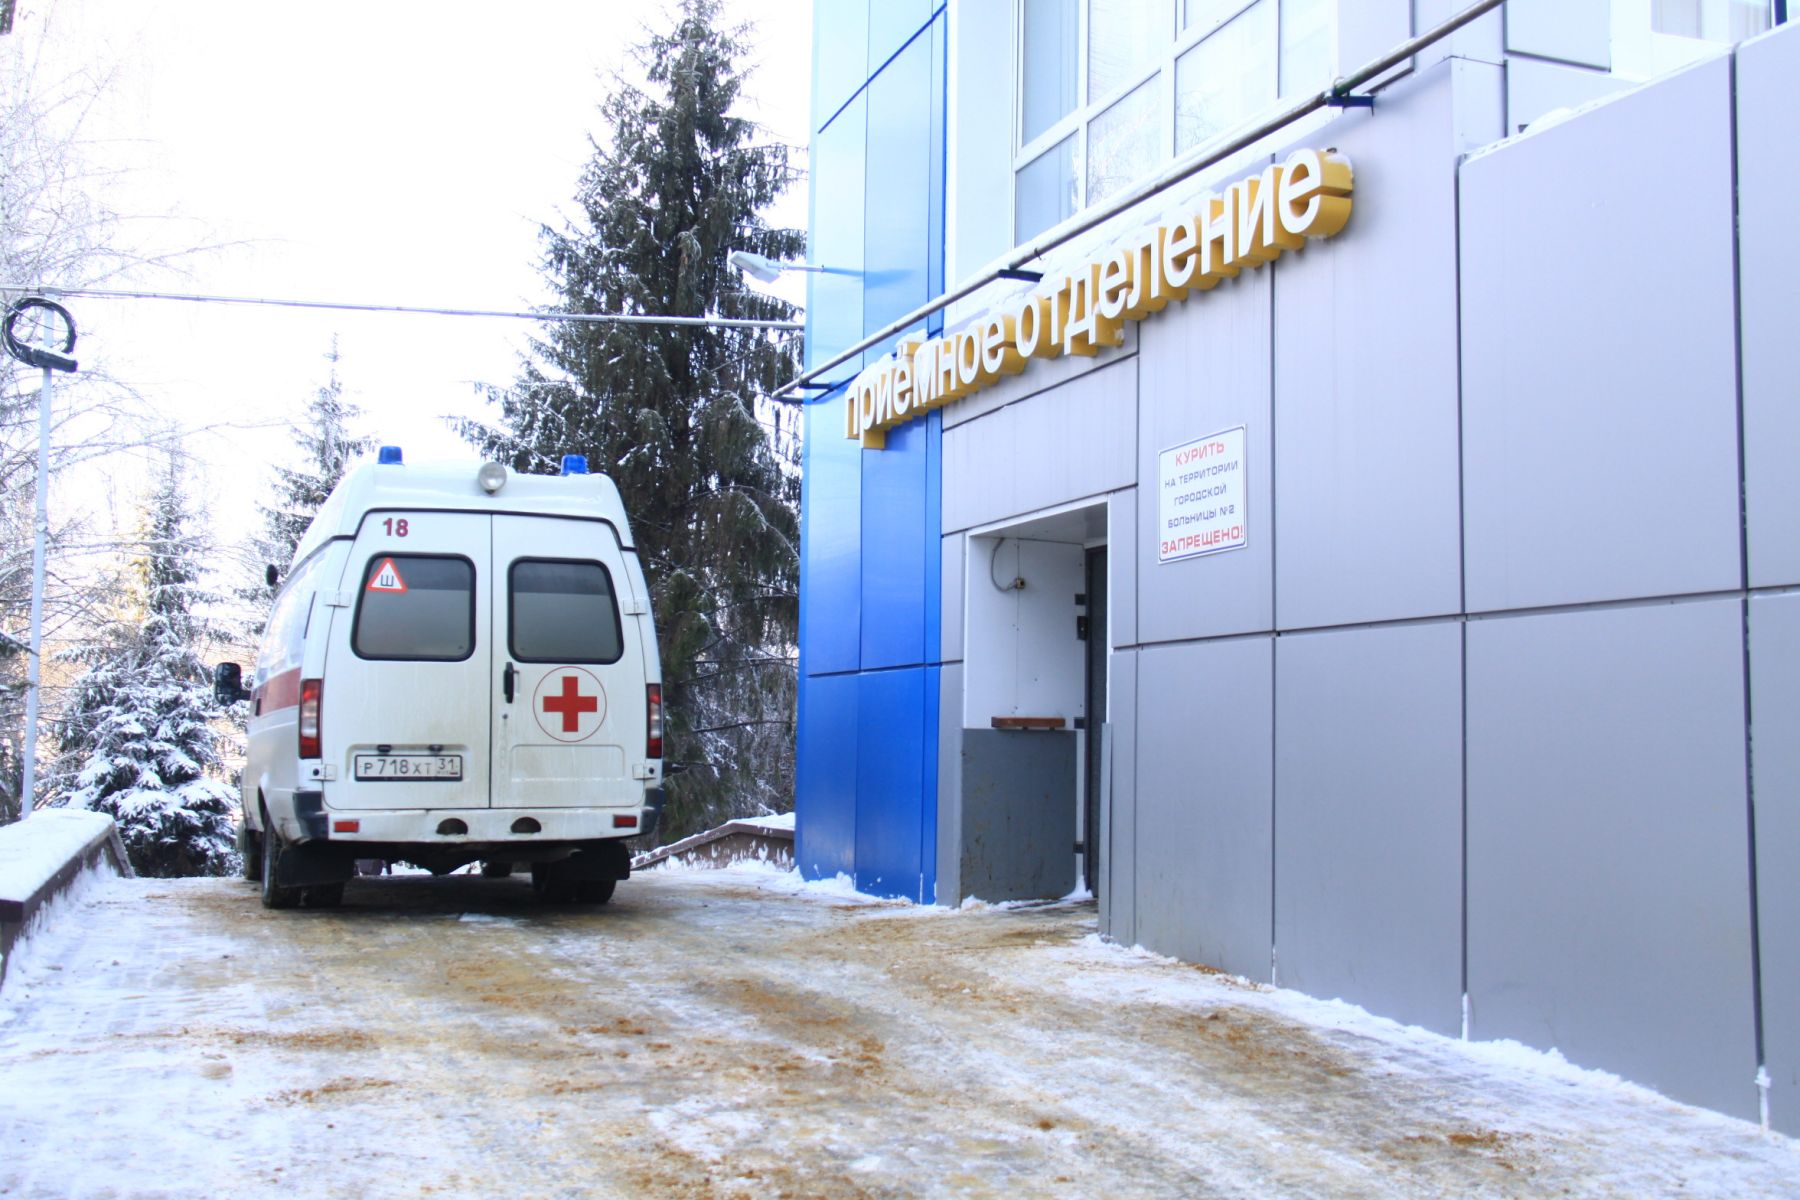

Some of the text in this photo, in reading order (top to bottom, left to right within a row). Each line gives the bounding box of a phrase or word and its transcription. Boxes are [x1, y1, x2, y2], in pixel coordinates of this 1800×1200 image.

[1175, 441, 1225, 466] КУРИТЬ
[1164, 460, 1238, 489] НА ТЕРРИТОРИИ
[1174, 483, 1227, 506] ГОРОДСКОЙ
[382, 517, 409, 538] 18
[1168, 504, 1235, 529] БОЛЬНИЦЫ №2
[1161, 524, 1244, 555] ЗАПРЕЩЕНО!
[380, 574, 394, 587] Ш
